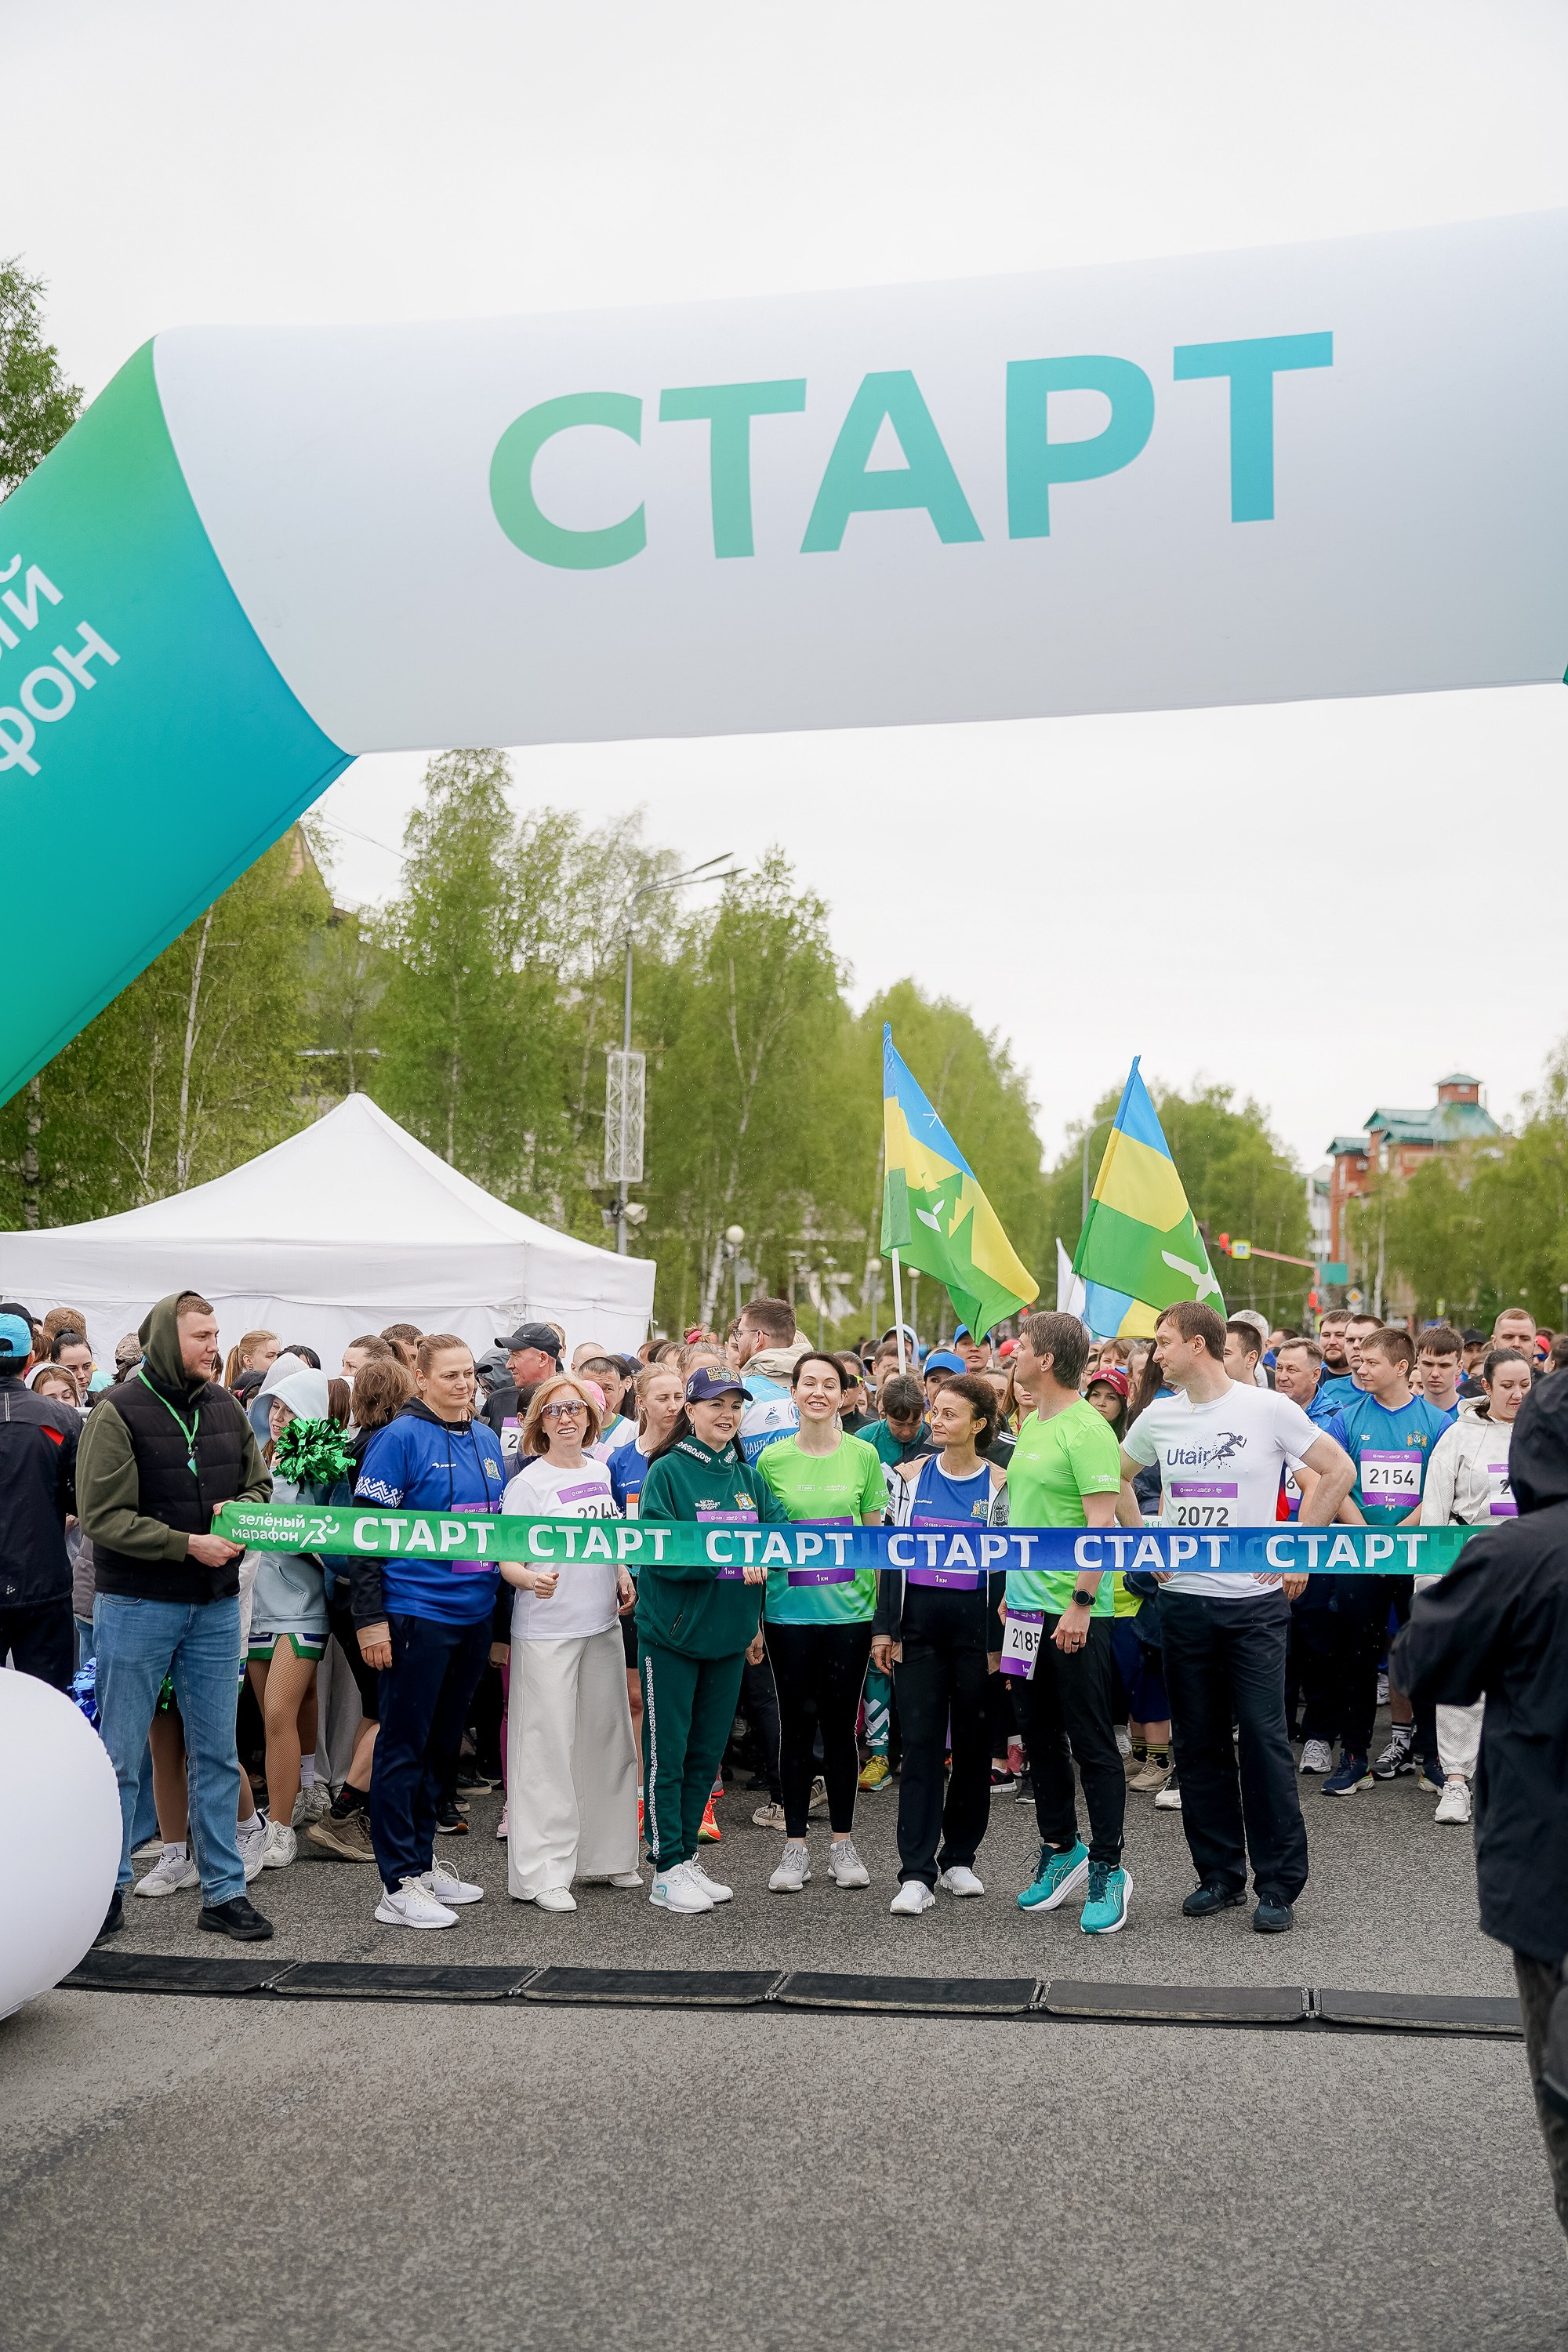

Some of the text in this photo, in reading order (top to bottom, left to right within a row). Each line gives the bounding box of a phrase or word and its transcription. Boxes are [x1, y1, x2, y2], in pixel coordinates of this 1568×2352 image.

[490, 331, 1334, 570] СТАРТ
[1167, 1448, 1211, 1466] Utair
[1369, 1468, 1414, 1486] 2154
[238, 1512, 306, 1529] зелёный
[1177, 1505, 1229, 1527] 2072
[231, 1526, 299, 1544] марафон
[353, 1516, 1428, 1568] СТАРТ СТАРТ СТАРТ СТАРТ СТАРТ СТАРТ
[1012, 1628, 1040, 1652] 2185
